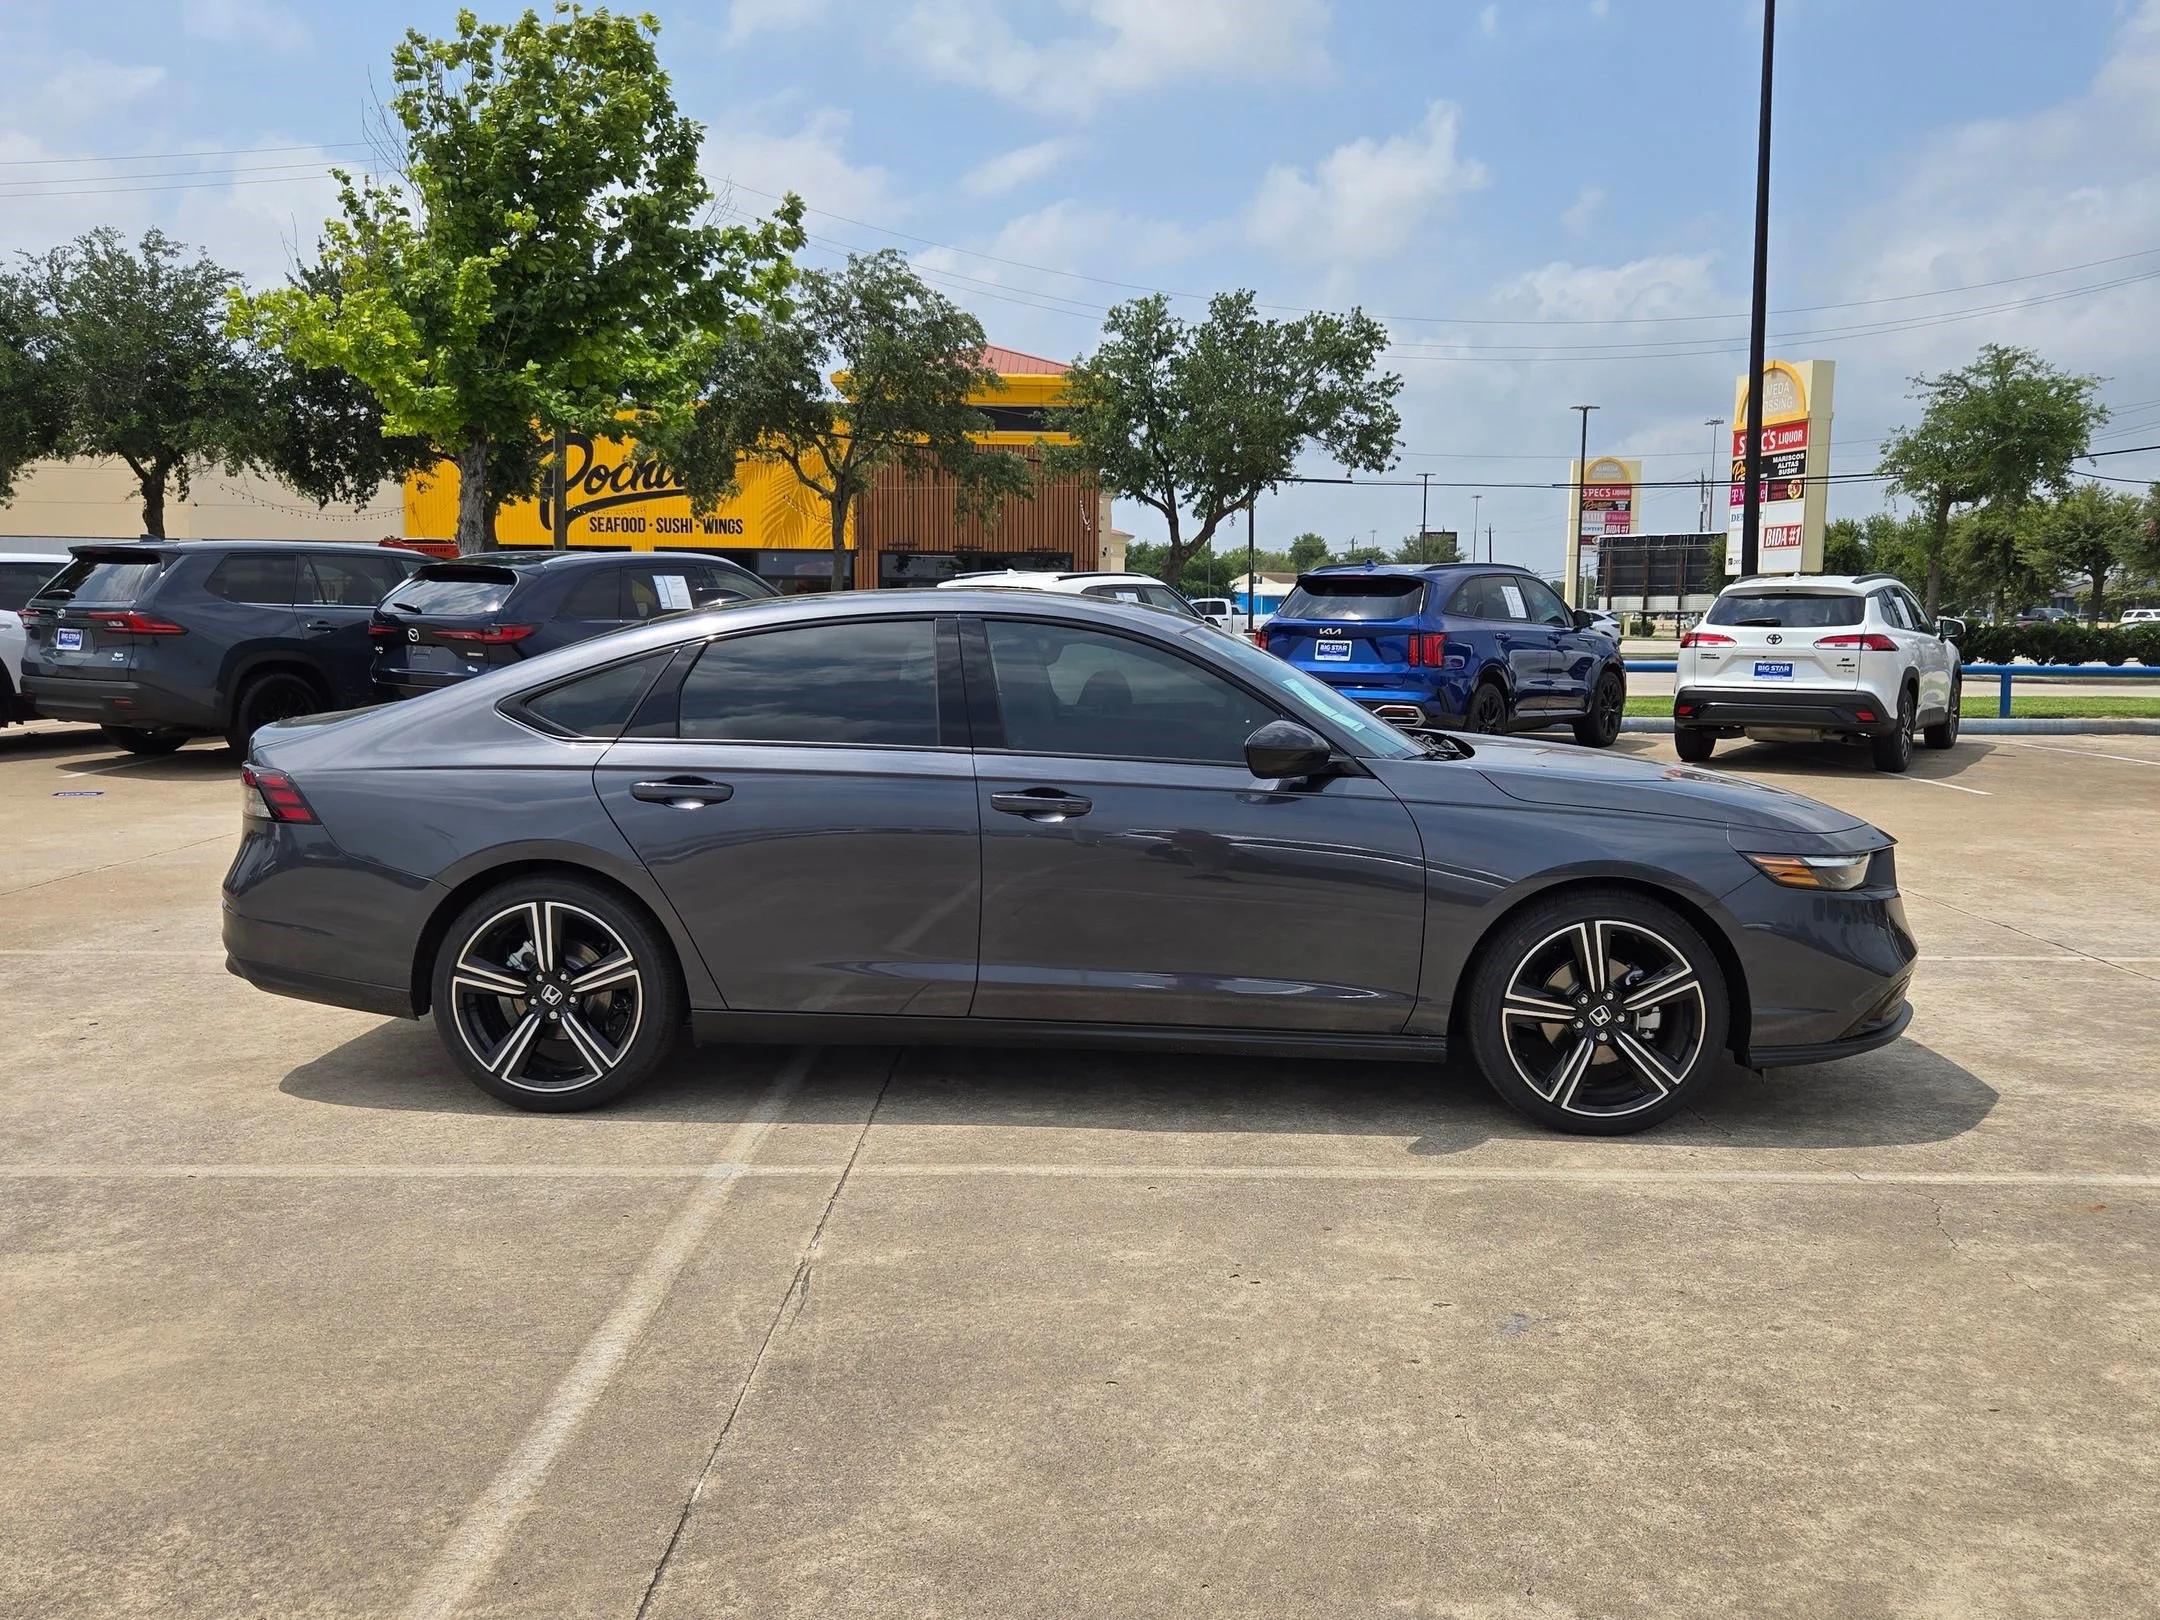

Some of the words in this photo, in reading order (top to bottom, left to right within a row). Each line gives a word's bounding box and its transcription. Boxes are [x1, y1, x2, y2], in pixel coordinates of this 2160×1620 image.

[1763, 381, 1790, 395] MEDA
[1739, 429, 1776, 454] SC'S
[1778, 430, 1803, 444] LIQUOR
[1772, 453, 1805, 463] MARISCOS
[1777, 461, 1799, 469] ALITAS
[589, 516, 646, 533] SEAFOOD
[656, 517, 693, 533] SUSHI
[702, 517, 743, 534] WINGS
[1765, 528, 1787, 547] BIDA
[1788, 526, 1801, 545] #1
